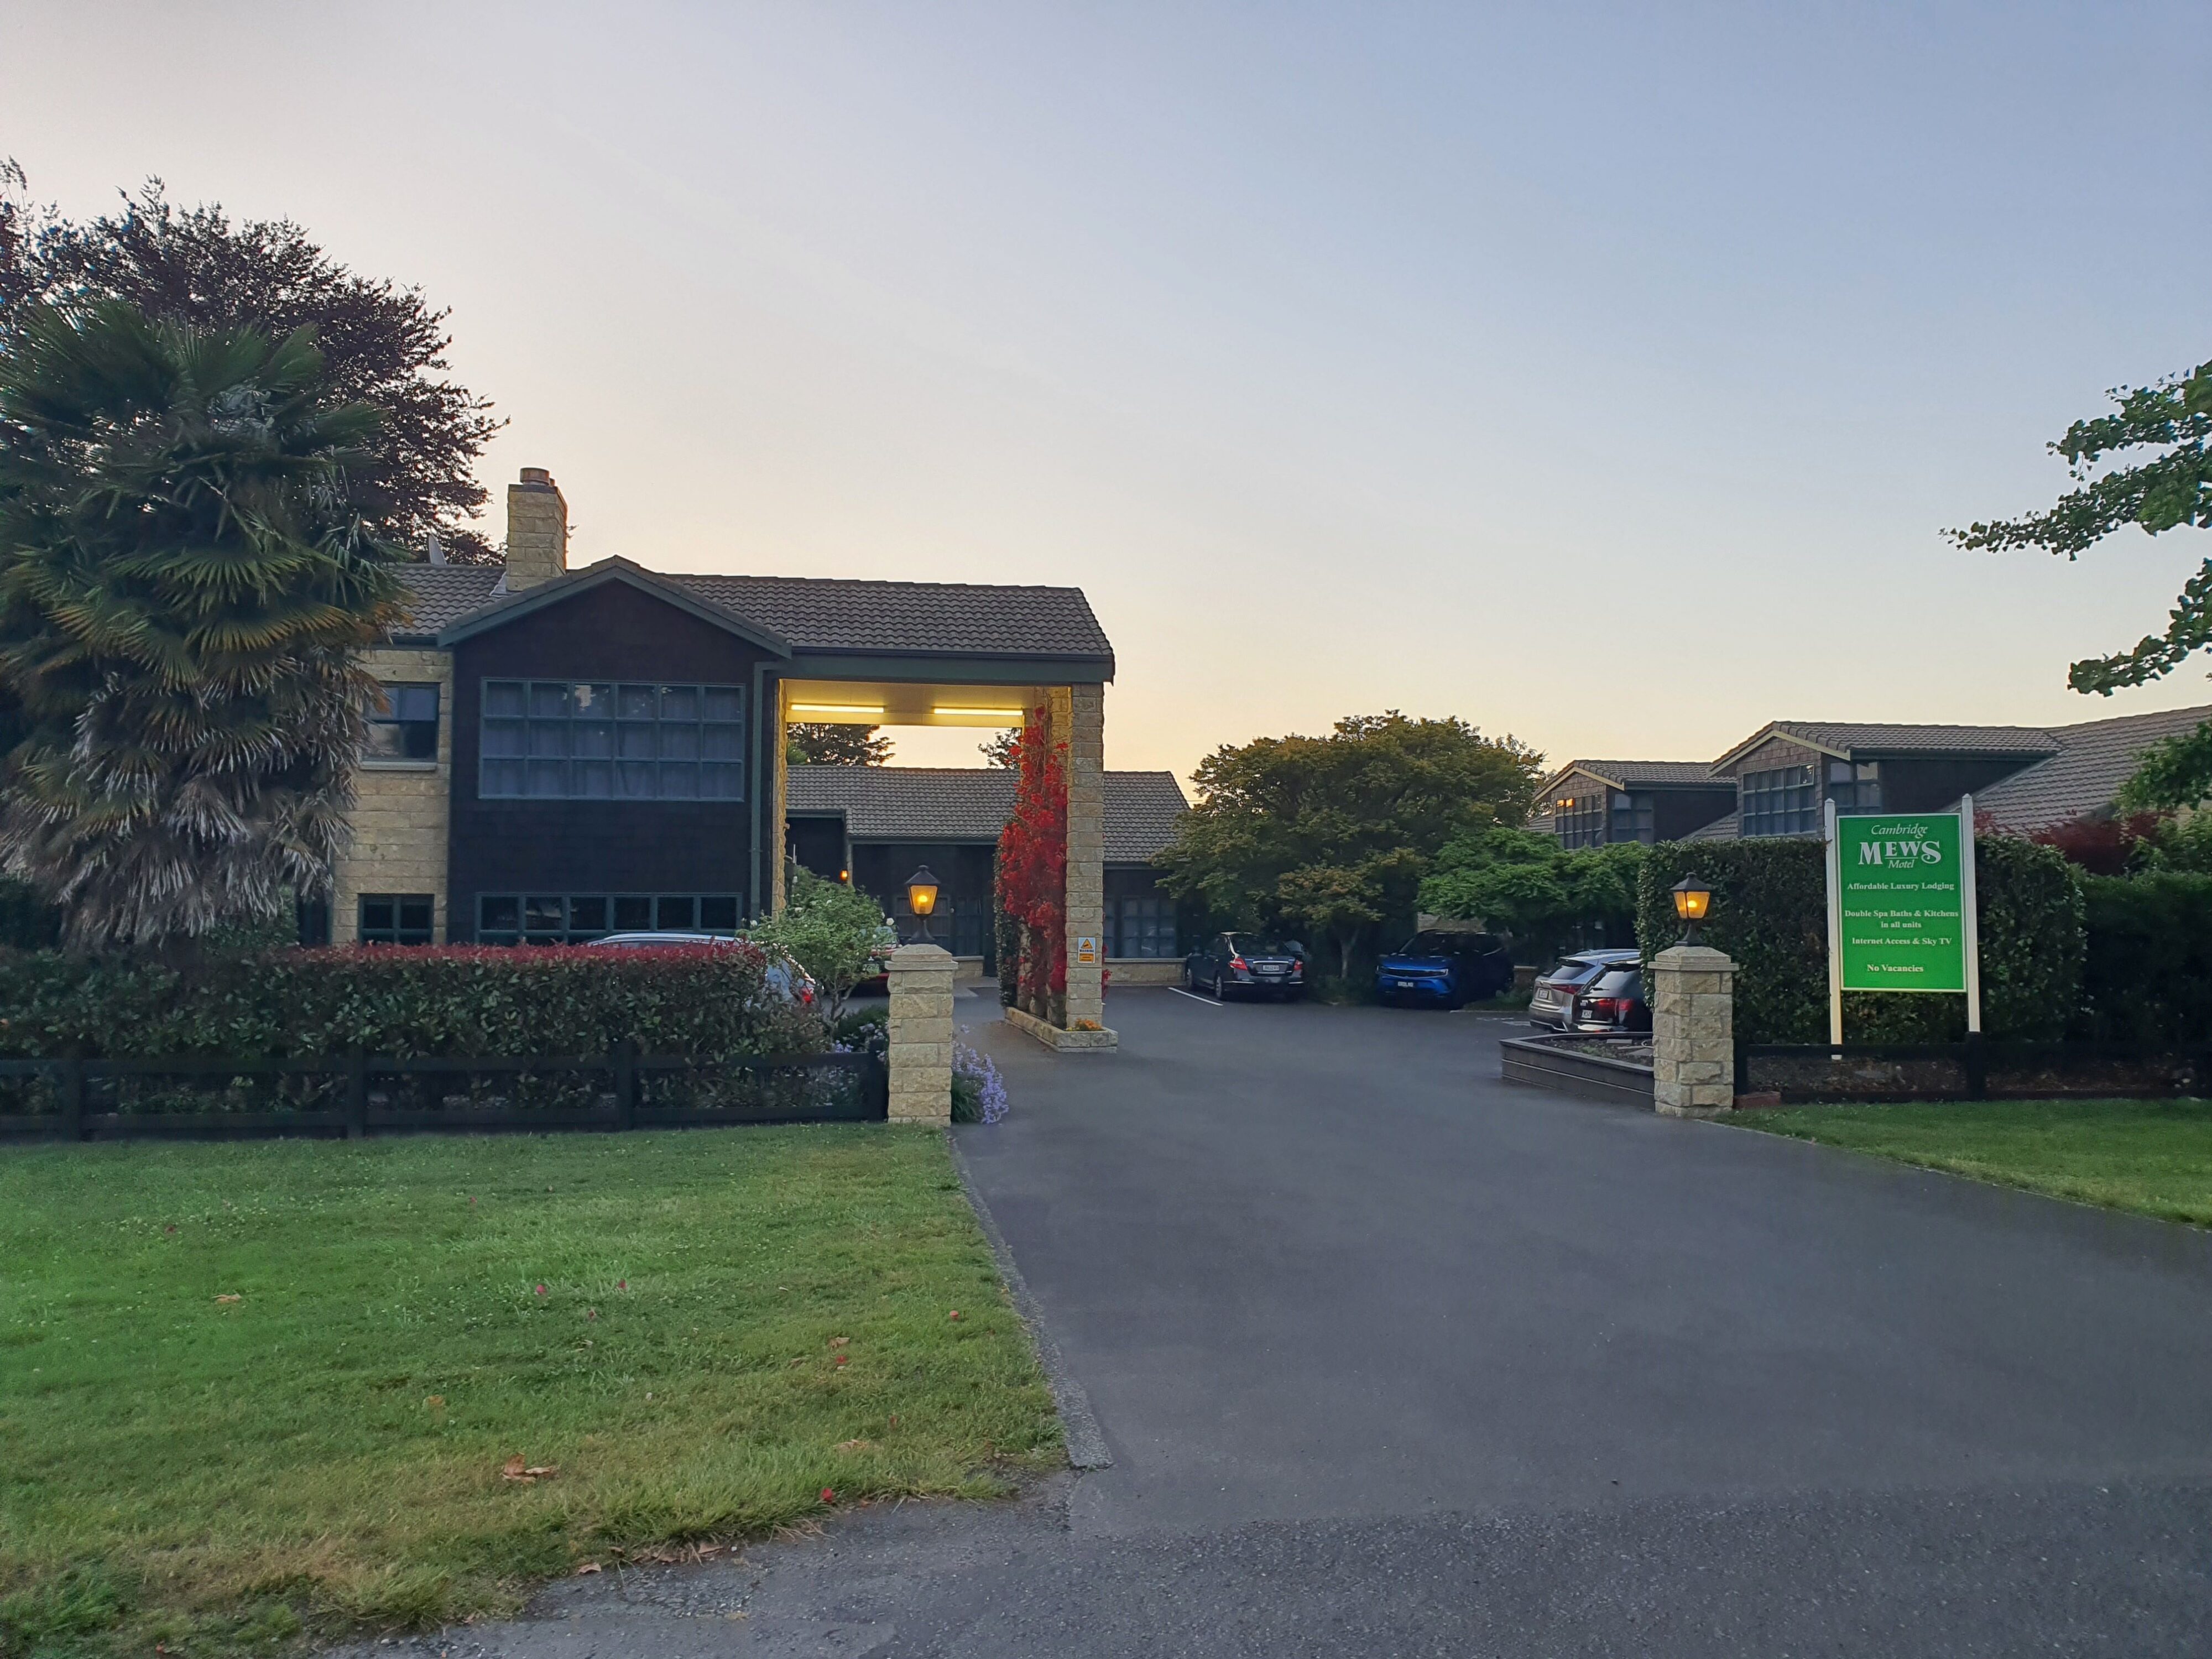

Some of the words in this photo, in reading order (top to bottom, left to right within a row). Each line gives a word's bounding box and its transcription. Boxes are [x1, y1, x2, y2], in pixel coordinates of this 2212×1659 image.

[1871, 823, 1928, 839] Cambridge
[1858, 841, 1942, 865] MEWS
[1888, 860, 1915, 868] Motel
[1890, 883, 1919, 891] Luxury
[1874, 910, 1888, 919] Spa
[1922, 938, 1937, 946] Sky
